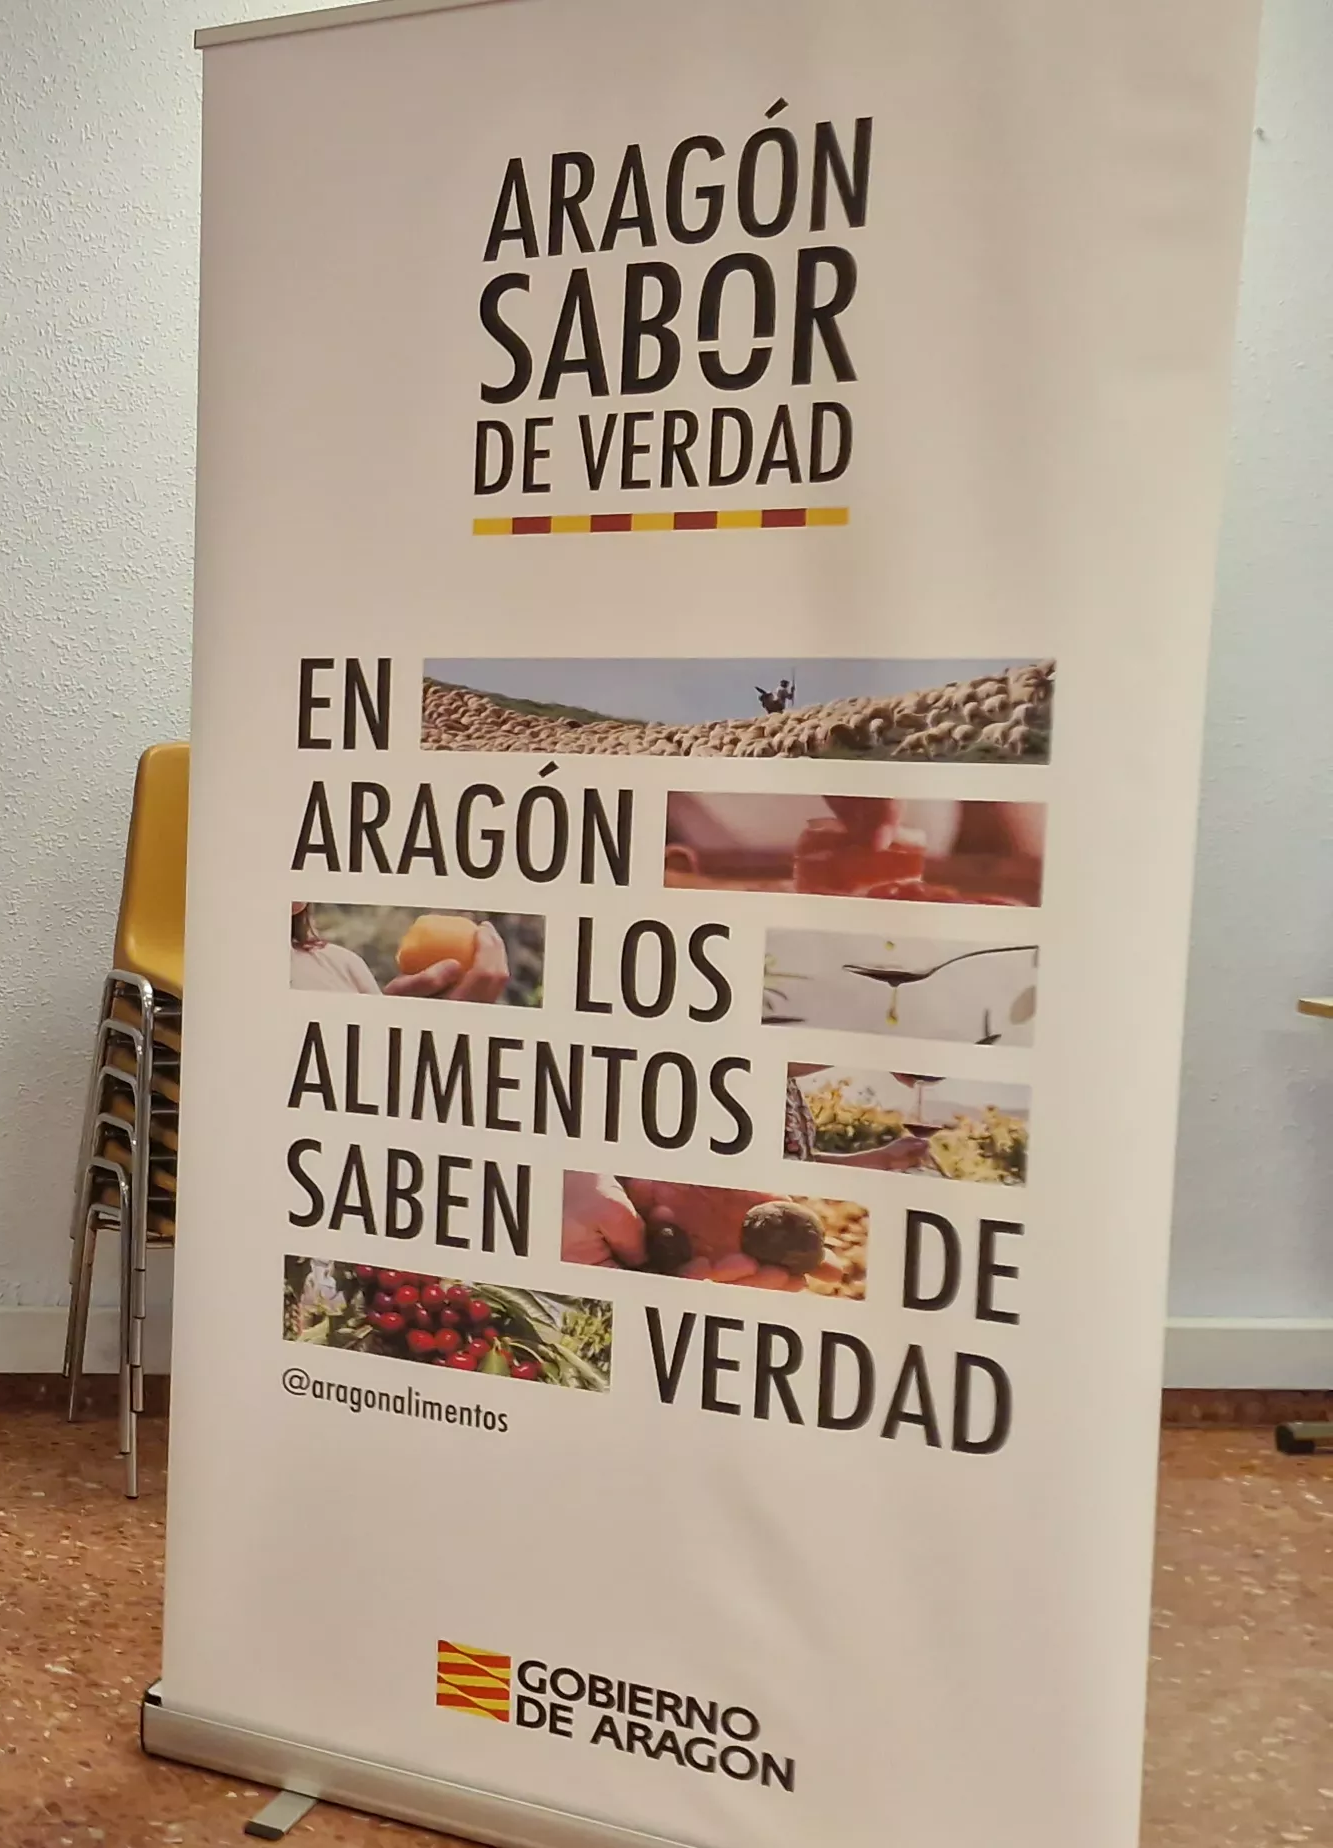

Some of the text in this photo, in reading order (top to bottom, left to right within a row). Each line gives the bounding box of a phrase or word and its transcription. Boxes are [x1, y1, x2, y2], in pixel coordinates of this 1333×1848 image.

[482, 96, 874, 262] ARAGÓN
[479, 245, 858, 405] SABOR
[474, 401, 854, 496] DE VERDAD
[297, 658, 393, 751] EN
[291, 761, 634, 887] ARAGÓN
[574, 915, 732, 1024] LOS
[288, 1020, 754, 1156] ALIMENTOS
[286, 1137, 1025, 1325] SABEN DE
[281, 1367, 510, 1435] @aragonalimentos
[644, 1306, 1013, 1456] VERDAD
[516, 1694, 796, 1793] DE ARAGON
[517, 1659, 761, 1742] GOBIERNO
